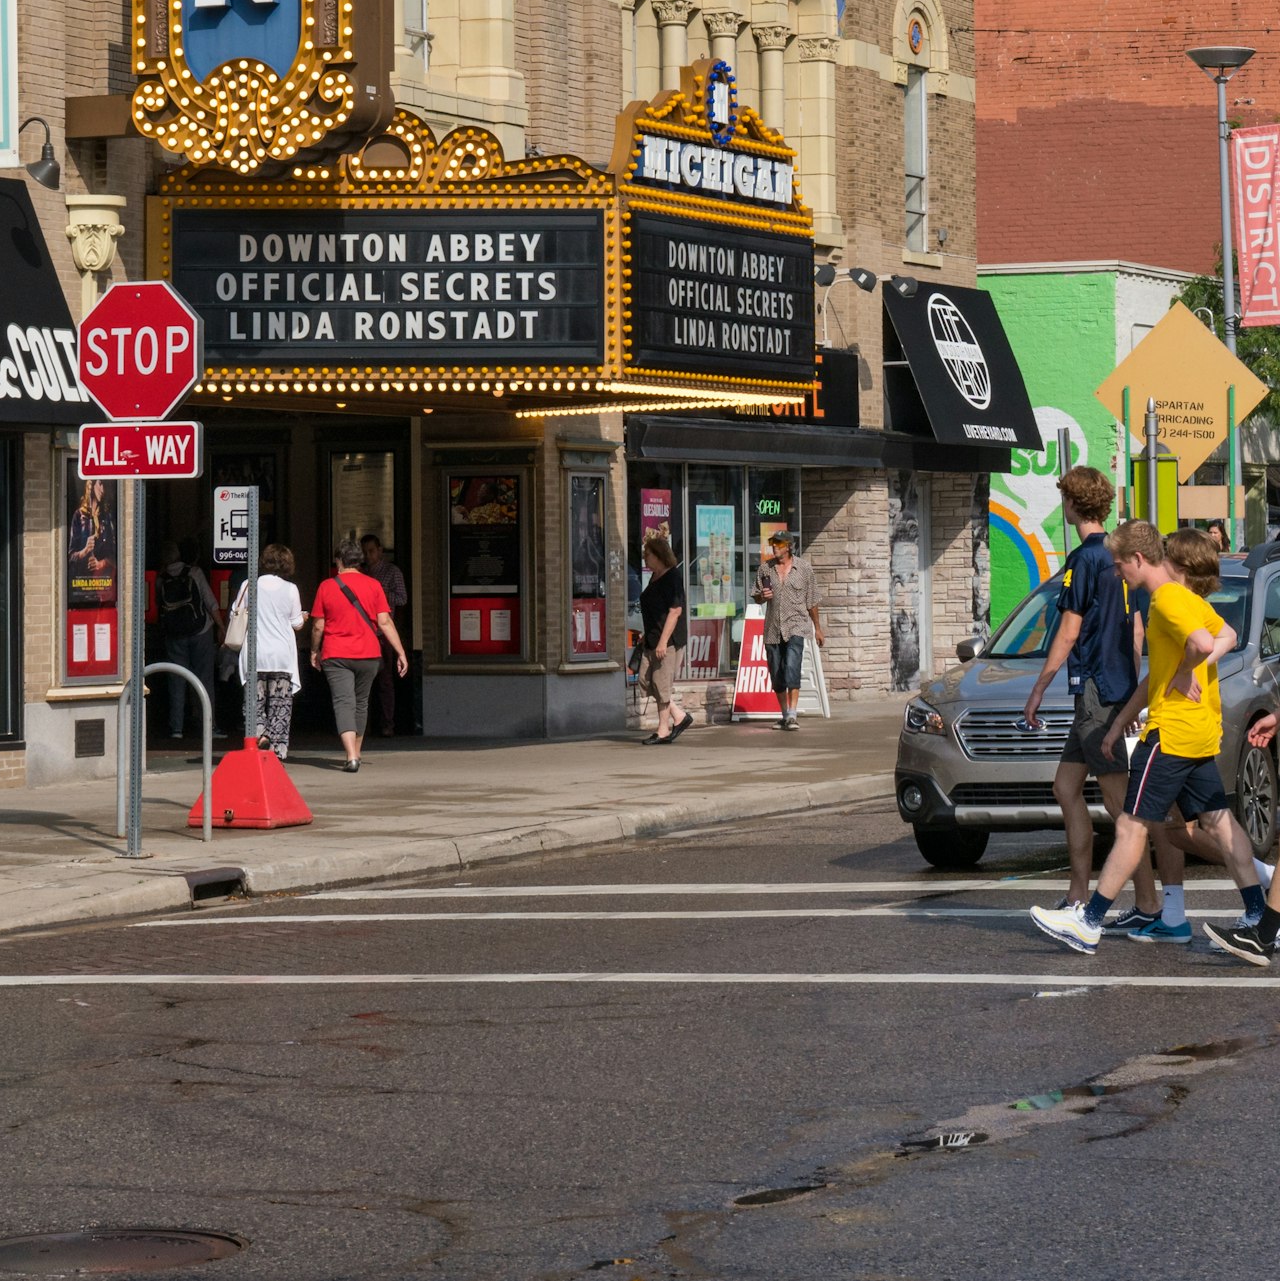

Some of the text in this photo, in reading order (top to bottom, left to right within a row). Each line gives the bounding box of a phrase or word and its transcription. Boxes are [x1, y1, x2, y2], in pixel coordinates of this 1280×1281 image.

[642, 134, 795, 207] MICHIGAN
[1245, 145, 1278, 307] DISTRICT
[240, 233, 540, 262] DOWNTON ABBEY
[669, 241, 784, 282] DOWNTON ABBEY
[217, 271, 556, 303] OFFICIAL SECRETS
[669, 278, 793, 320] OFFICIAL SECRETS
[231, 311, 538, 342] LINDA RONSTADT
[675, 317, 792, 355] LINDA RONSTADT
[85, 326, 191, 377] STOP
[1155, 400, 1204, 412] SPARTAN
[1169, 428, 1215, 440] 244-1500
[85, 435, 190, 466] ALL WAY
[757, 499, 782, 516] OPEN
